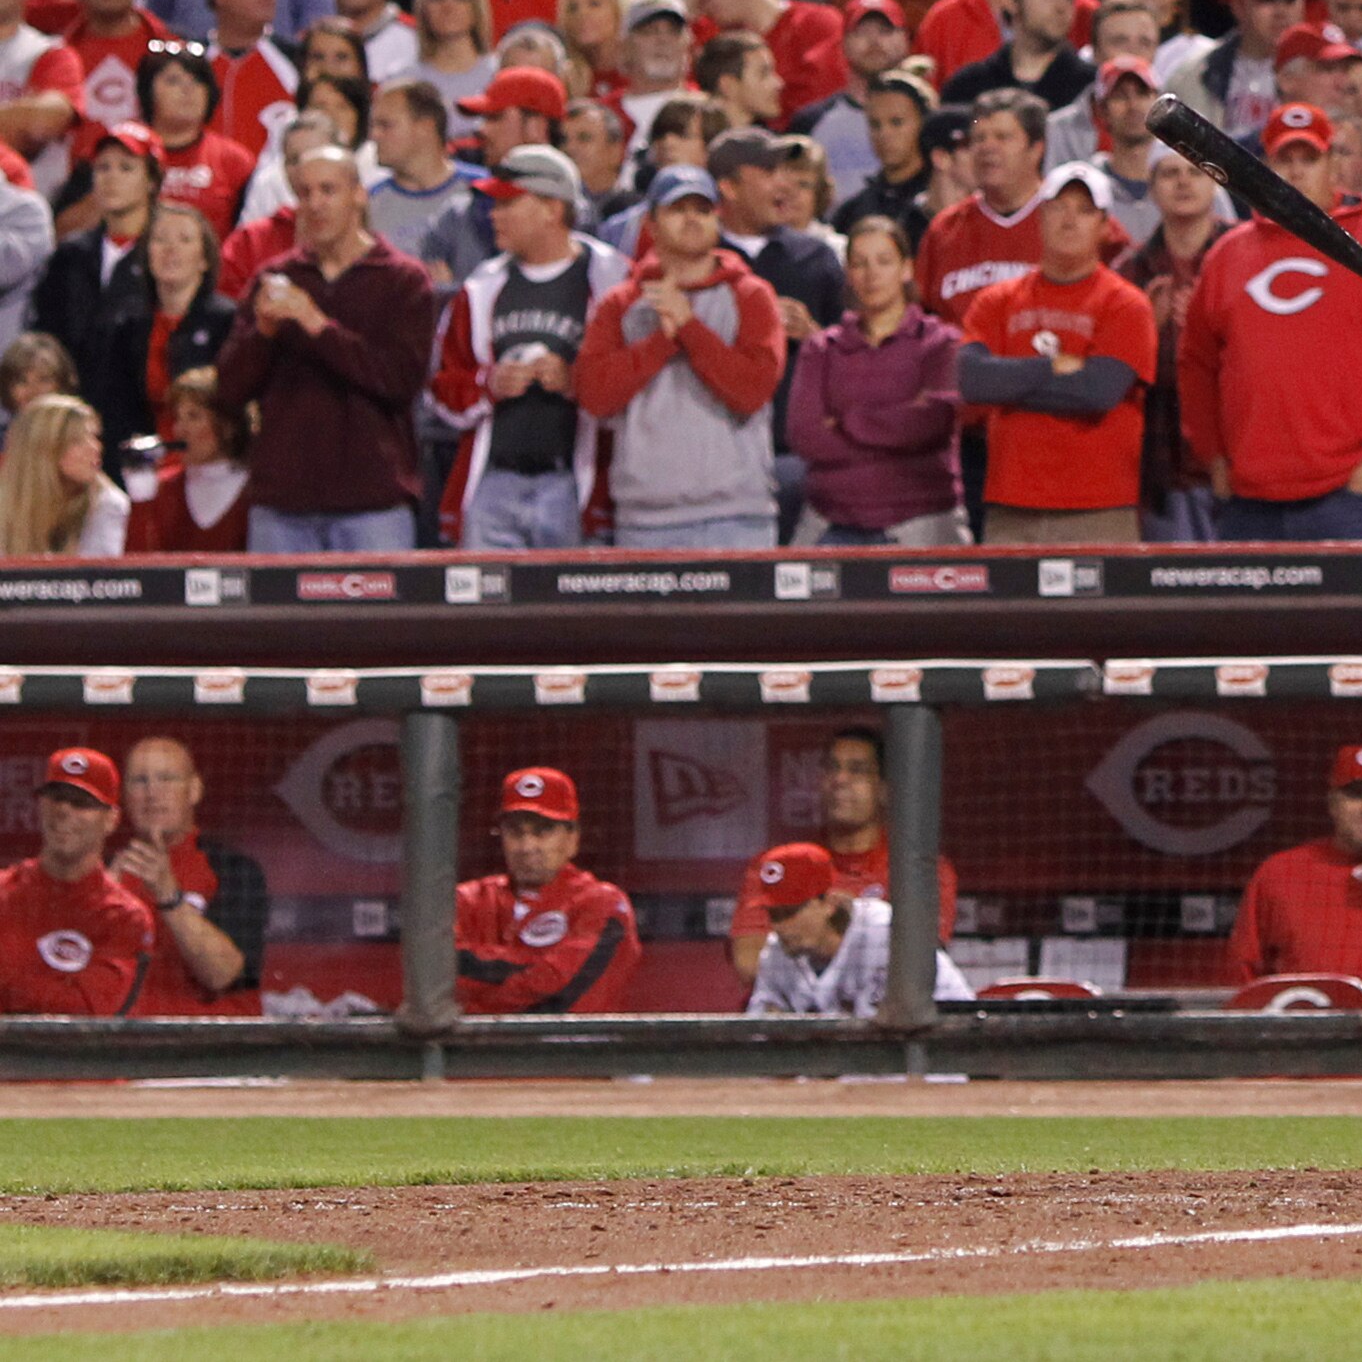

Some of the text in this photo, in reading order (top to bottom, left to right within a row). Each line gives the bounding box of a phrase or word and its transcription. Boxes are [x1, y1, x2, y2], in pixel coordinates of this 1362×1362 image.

[1245, 256, 1329, 315] C
[558, 572, 730, 595] neweracap.com
[1151, 566, 1322, 589] neweracap.com
[1144, 767, 1277, 801] REDS
